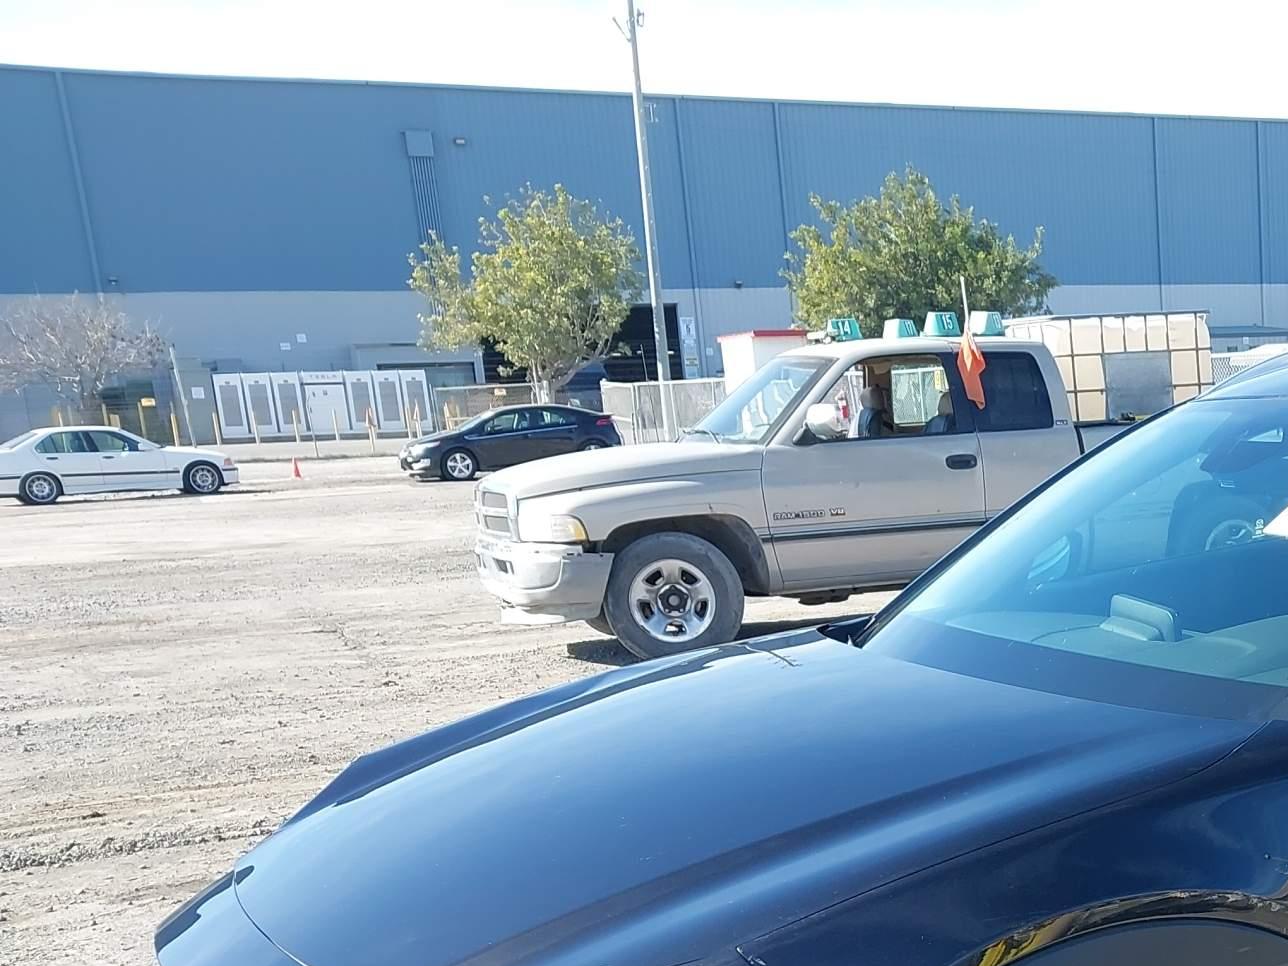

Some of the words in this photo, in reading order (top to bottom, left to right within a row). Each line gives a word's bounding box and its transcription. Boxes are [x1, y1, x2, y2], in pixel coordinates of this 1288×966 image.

[837, 320, 852, 336] 14
[941, 313, 953, 330] 15
[772, 511, 796, 521] RAM
[798, 509, 825, 519] 1500
[829, 507, 846, 516] V8
